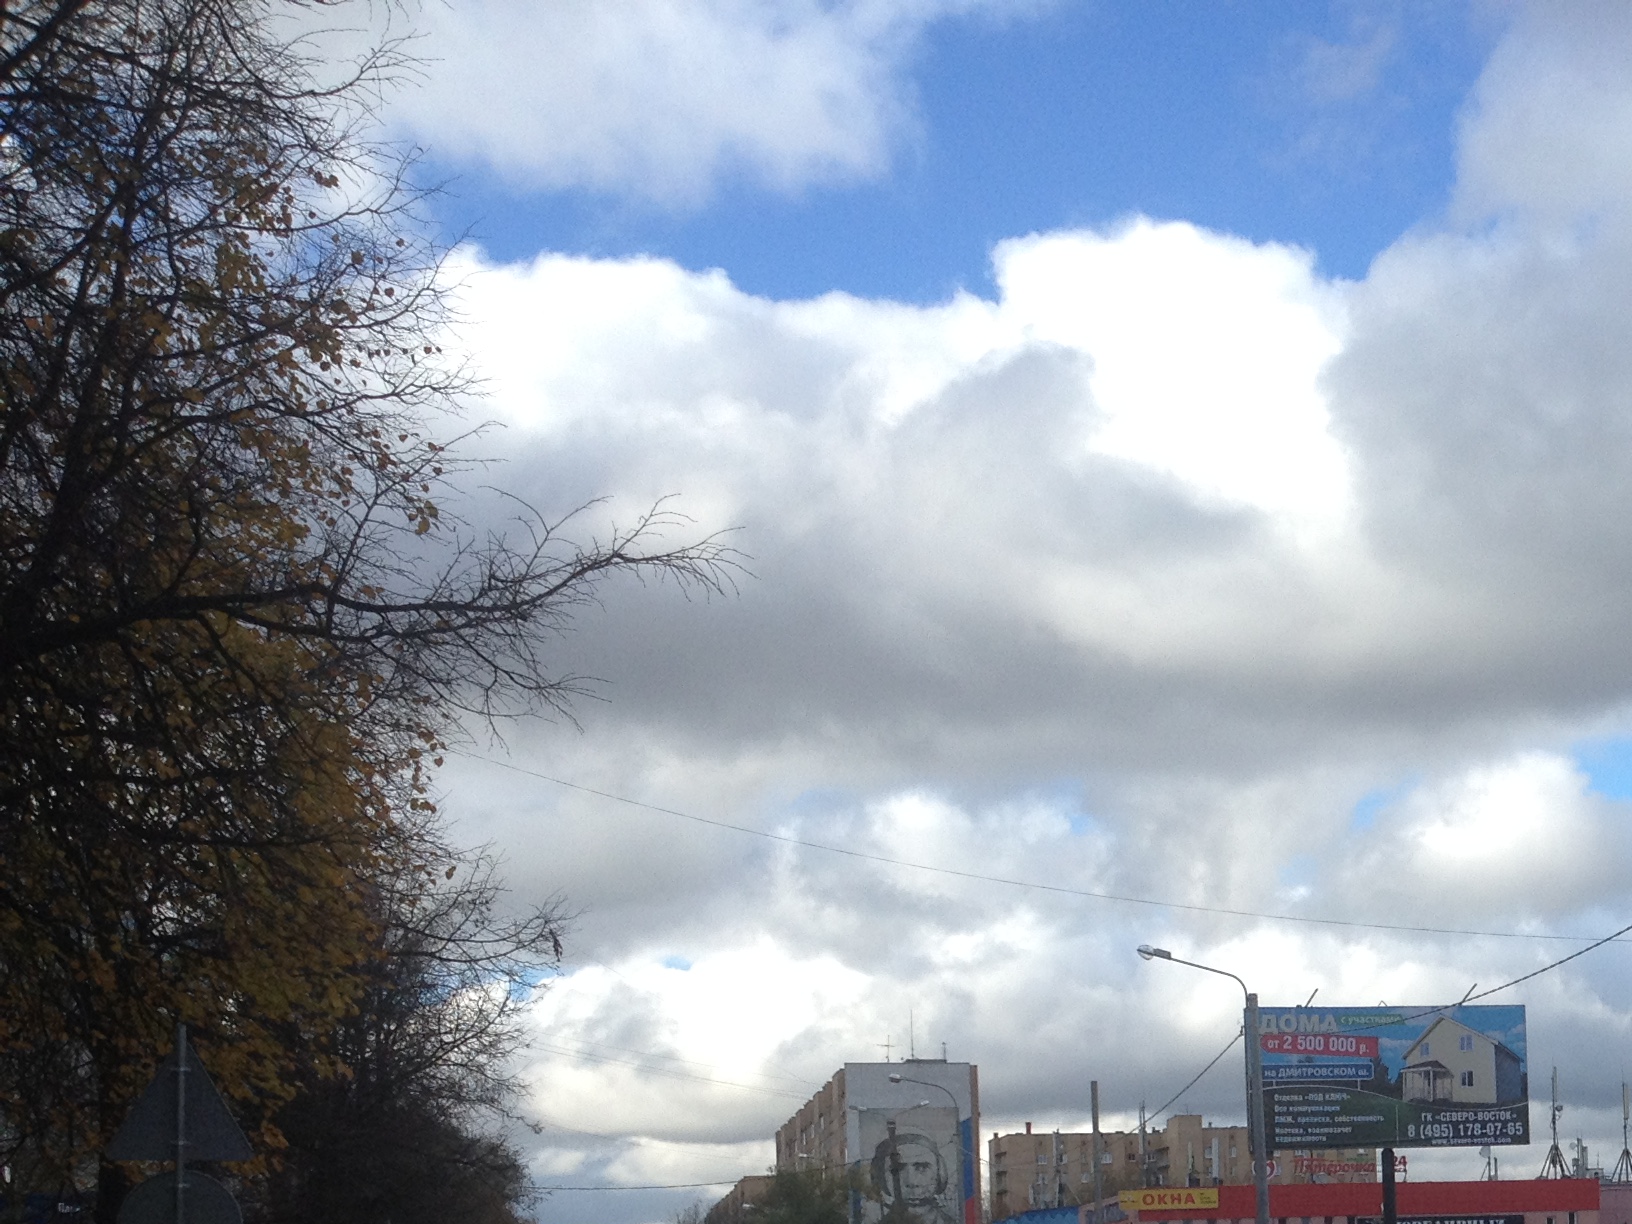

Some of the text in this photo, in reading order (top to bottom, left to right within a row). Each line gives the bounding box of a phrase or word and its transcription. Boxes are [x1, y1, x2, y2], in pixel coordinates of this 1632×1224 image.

[1258, 1013, 1339, 1034] ДОМА
[1267, 1039, 1280, 1049] от
[1283, 1036, 1292, 1049] 2
[1297, 1036, 1324, 1051] 500
[1329, 1037, 1356, 1052] 000
[1264, 1069, 1276, 1077] на
[1278, 1067, 1356, 1078] ДМИТРОВСКОМ
[1421, 1112, 1433, 1122] ГК
[1407, 1122, 1523, 1139] 8 (495) 178-07-65
[1142, 1193, 1196, 1206] ОКНА
